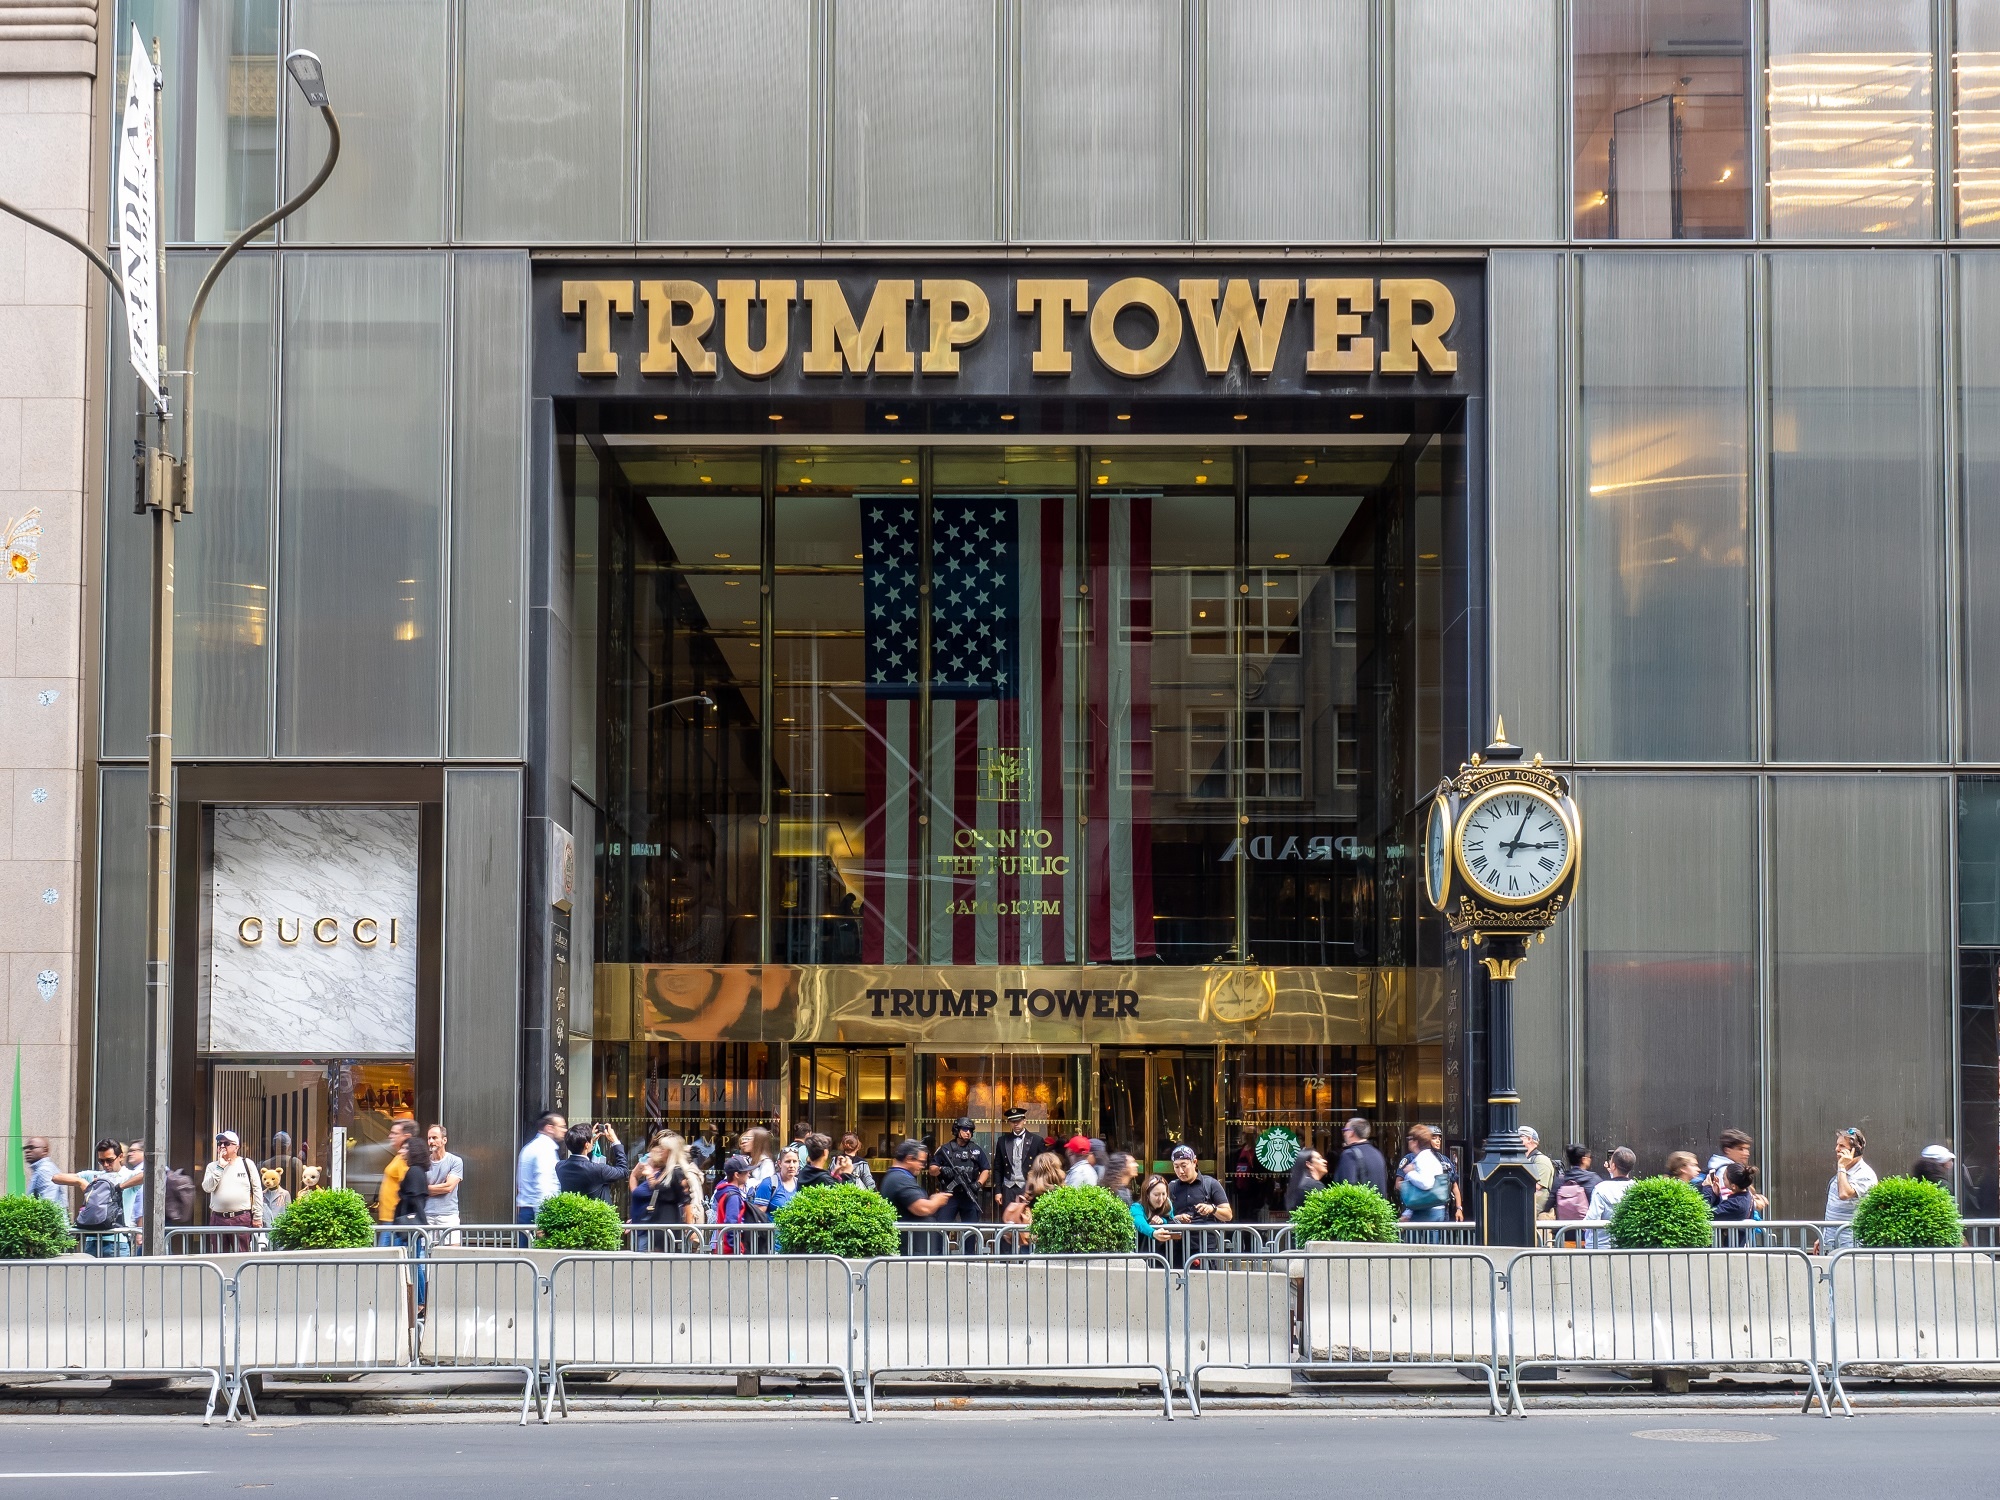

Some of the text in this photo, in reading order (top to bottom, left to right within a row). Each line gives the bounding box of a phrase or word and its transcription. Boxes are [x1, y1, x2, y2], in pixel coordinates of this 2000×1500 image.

[123, 73, 144, 350] FINDLAY
[562, 277, 1458, 379] TRUMP TOWER
[1473, 770, 1551, 789] TRUMP TOWER
[1506, 800, 1520, 816] XII
[954, 829, 1053, 848] OPEN TO
[937, 856, 1070, 875] THE PUBLIC
[238, 916, 397, 945] GUCCI
[866, 988, 1140, 1018] TRUMP TOWER
[681, 1073, 704, 1086] 725
[1302, 1077, 1326, 1090] 725
